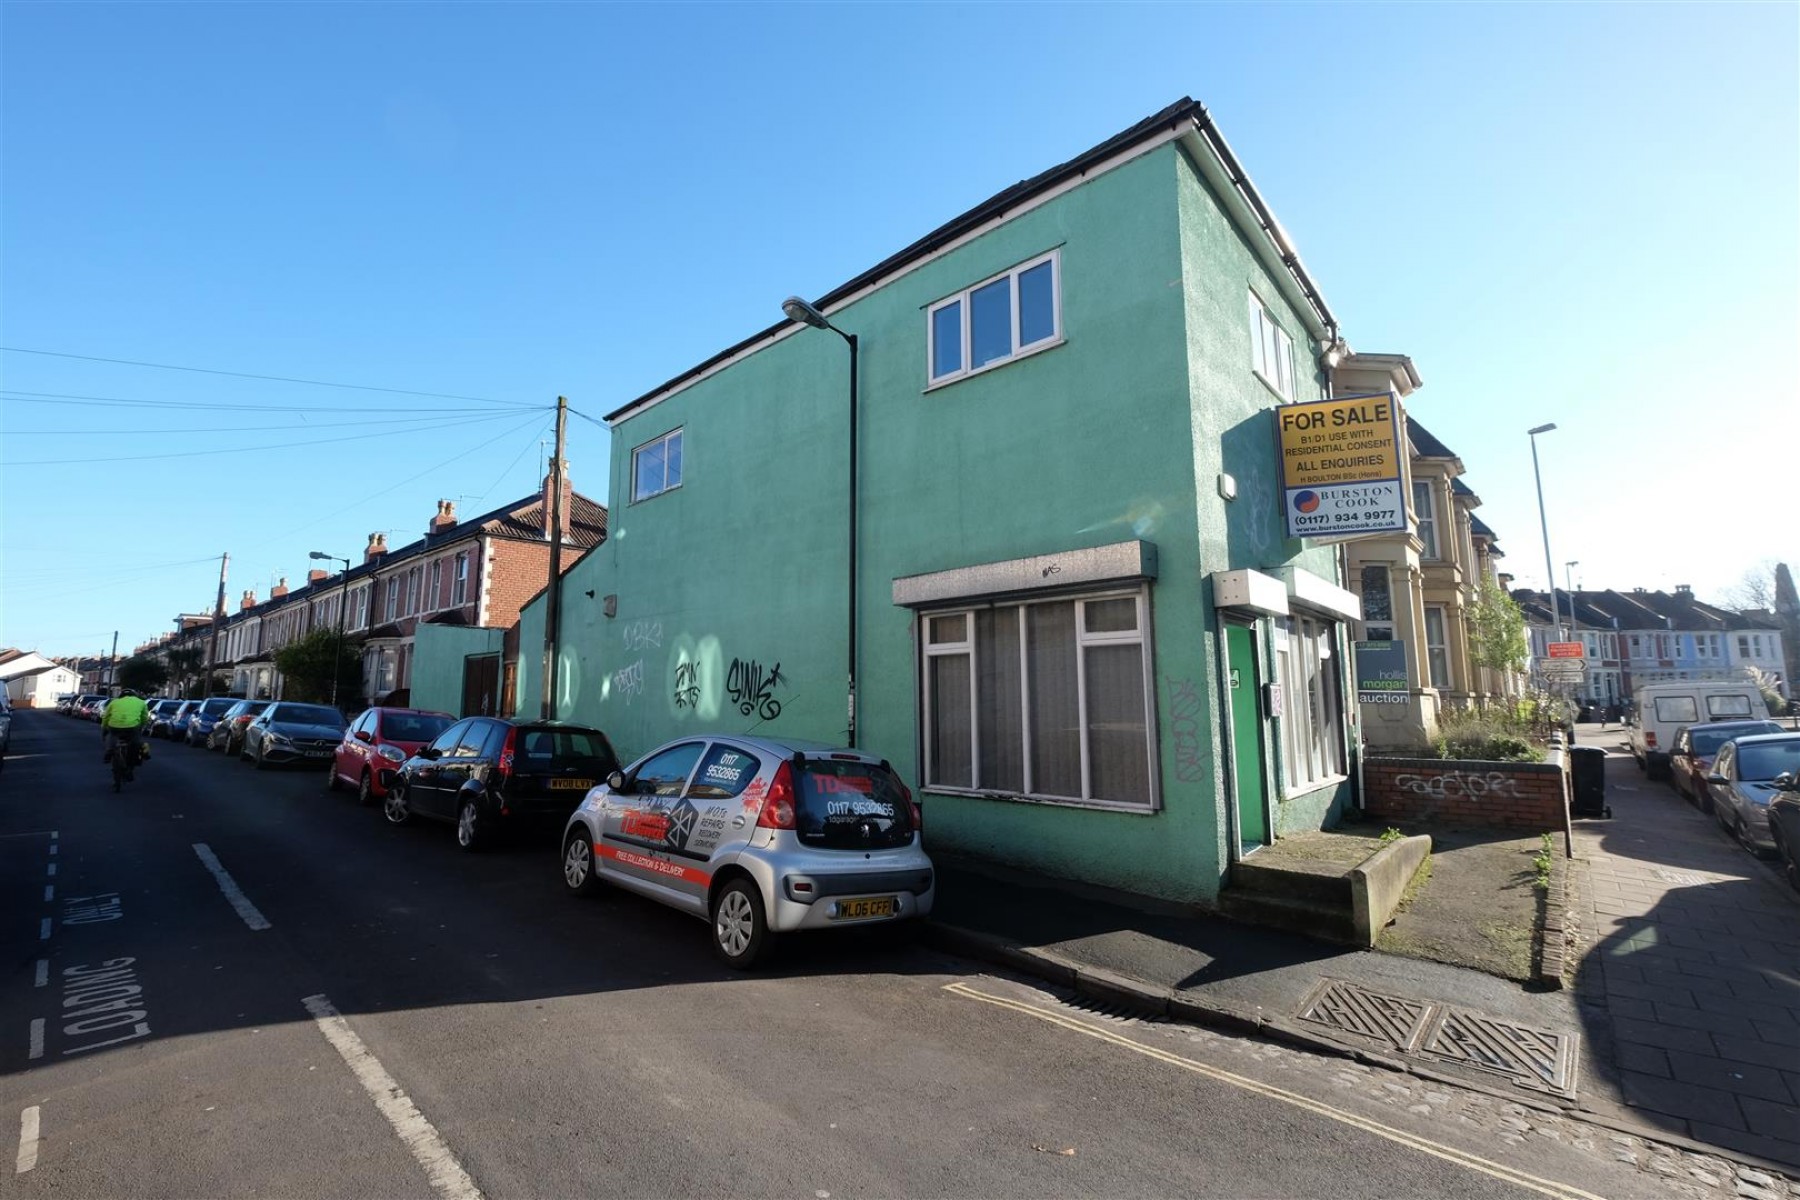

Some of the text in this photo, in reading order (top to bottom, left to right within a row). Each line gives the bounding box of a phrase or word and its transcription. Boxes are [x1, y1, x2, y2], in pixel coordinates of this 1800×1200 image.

[1283, 404, 1389, 432] FOR SALE
[1328, 431, 1348, 442] USE
[1350, 429, 1373, 439] WITH
[1285, 438, 1392, 457] RESIDENTIAL CONSENT
[1296, 454, 1384, 472] ALL ENQUIRIES
[1307, 473, 1341, 482] BOULTON
[1320, 486, 1393, 500] BURSTON
[1335, 497, 1379, 509] COOK
[1295, 510, 1395, 525] (0117) 934 9977
[1295, 519, 1396, 532] www.burstoncook.co.uk
[1379, 669, 1407, 680] hollis
[1363, 680, 1407, 690] morgan
[1359, 693, 1409, 703] auction
[721, 753, 740, 766] 0117
[706, 764, 741, 780] 9532865
[813, 773, 840, 794] TD
[827, 801, 895, 817] 0117 9532865
[659, 861, 686, 877] DELIVERY
[841, 900, 890, 917] WL06 CFF
[62, 957, 151, 1054] LOADING
